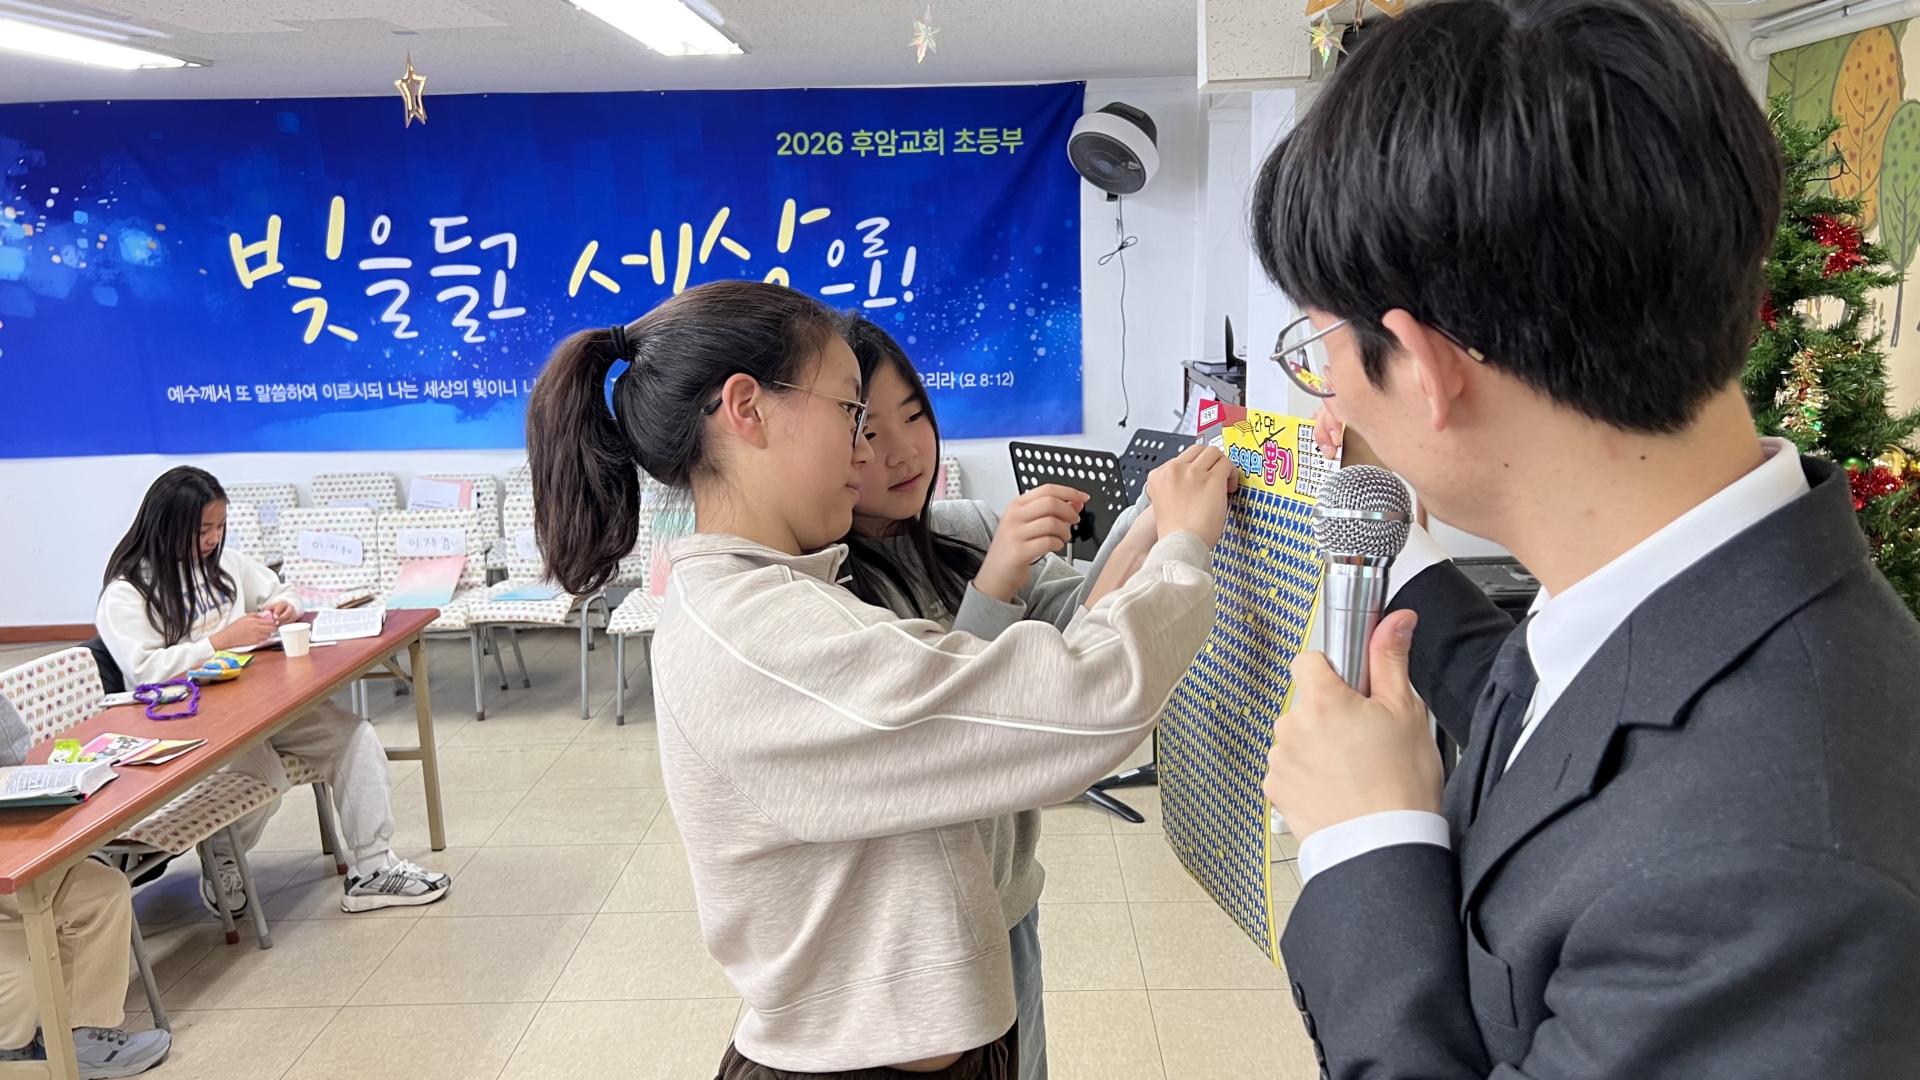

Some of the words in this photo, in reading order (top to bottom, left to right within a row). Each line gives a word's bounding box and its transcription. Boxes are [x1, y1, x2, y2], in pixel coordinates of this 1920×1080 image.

[776, 132, 844, 156] 2026
[851, 129, 944, 157] 후암교회
[953, 128, 1024, 156] 초등부
[167, 384, 231, 404] 예수께서
[236, 384, 252, 402] 또
[255, 382, 318, 403] 말씀하여
[322, 381, 383, 401] 이르시되
[388, 380, 419, 400] 나는
[424, 379, 468, 399] 세상의
[473, 378, 517, 398] 빛이니
[959, 372, 977, 390] (요
[980, 370, 1014, 388] 8:12)
[1255, 413, 1276, 435] 라면
[1263, 438, 1294, 486] 뽑기
